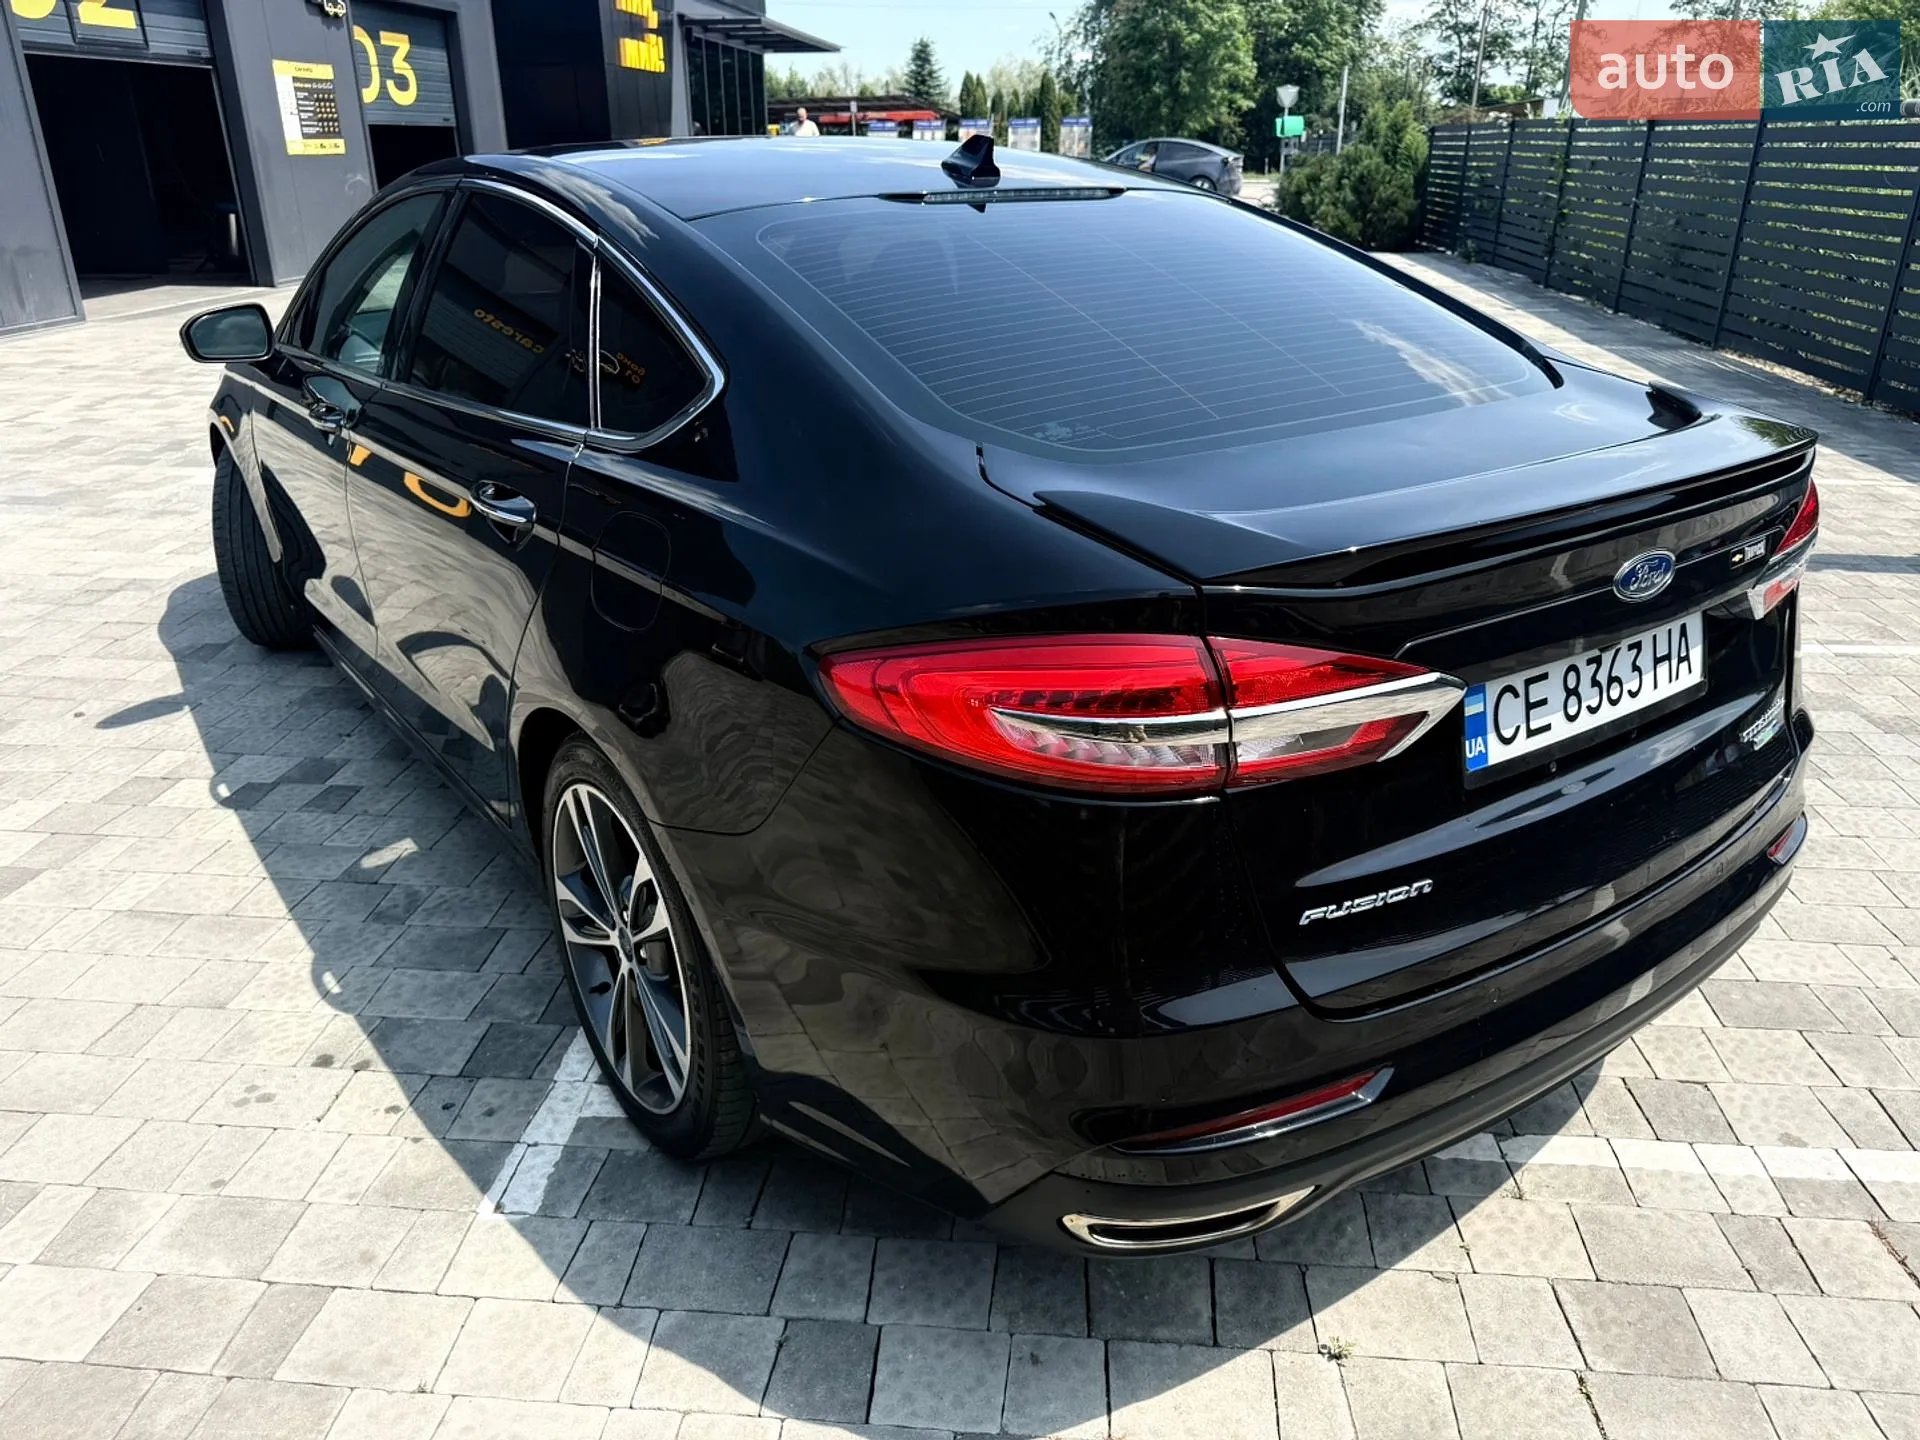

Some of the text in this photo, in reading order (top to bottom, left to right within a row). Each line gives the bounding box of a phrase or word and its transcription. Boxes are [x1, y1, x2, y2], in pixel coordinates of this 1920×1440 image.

[1629, 559, 1664, 590] Ford
[1493, 622, 1692, 746] CE 8363 HA
[1465, 738, 1486, 758] UA
[1299, 878, 1434, 926] FUSION
